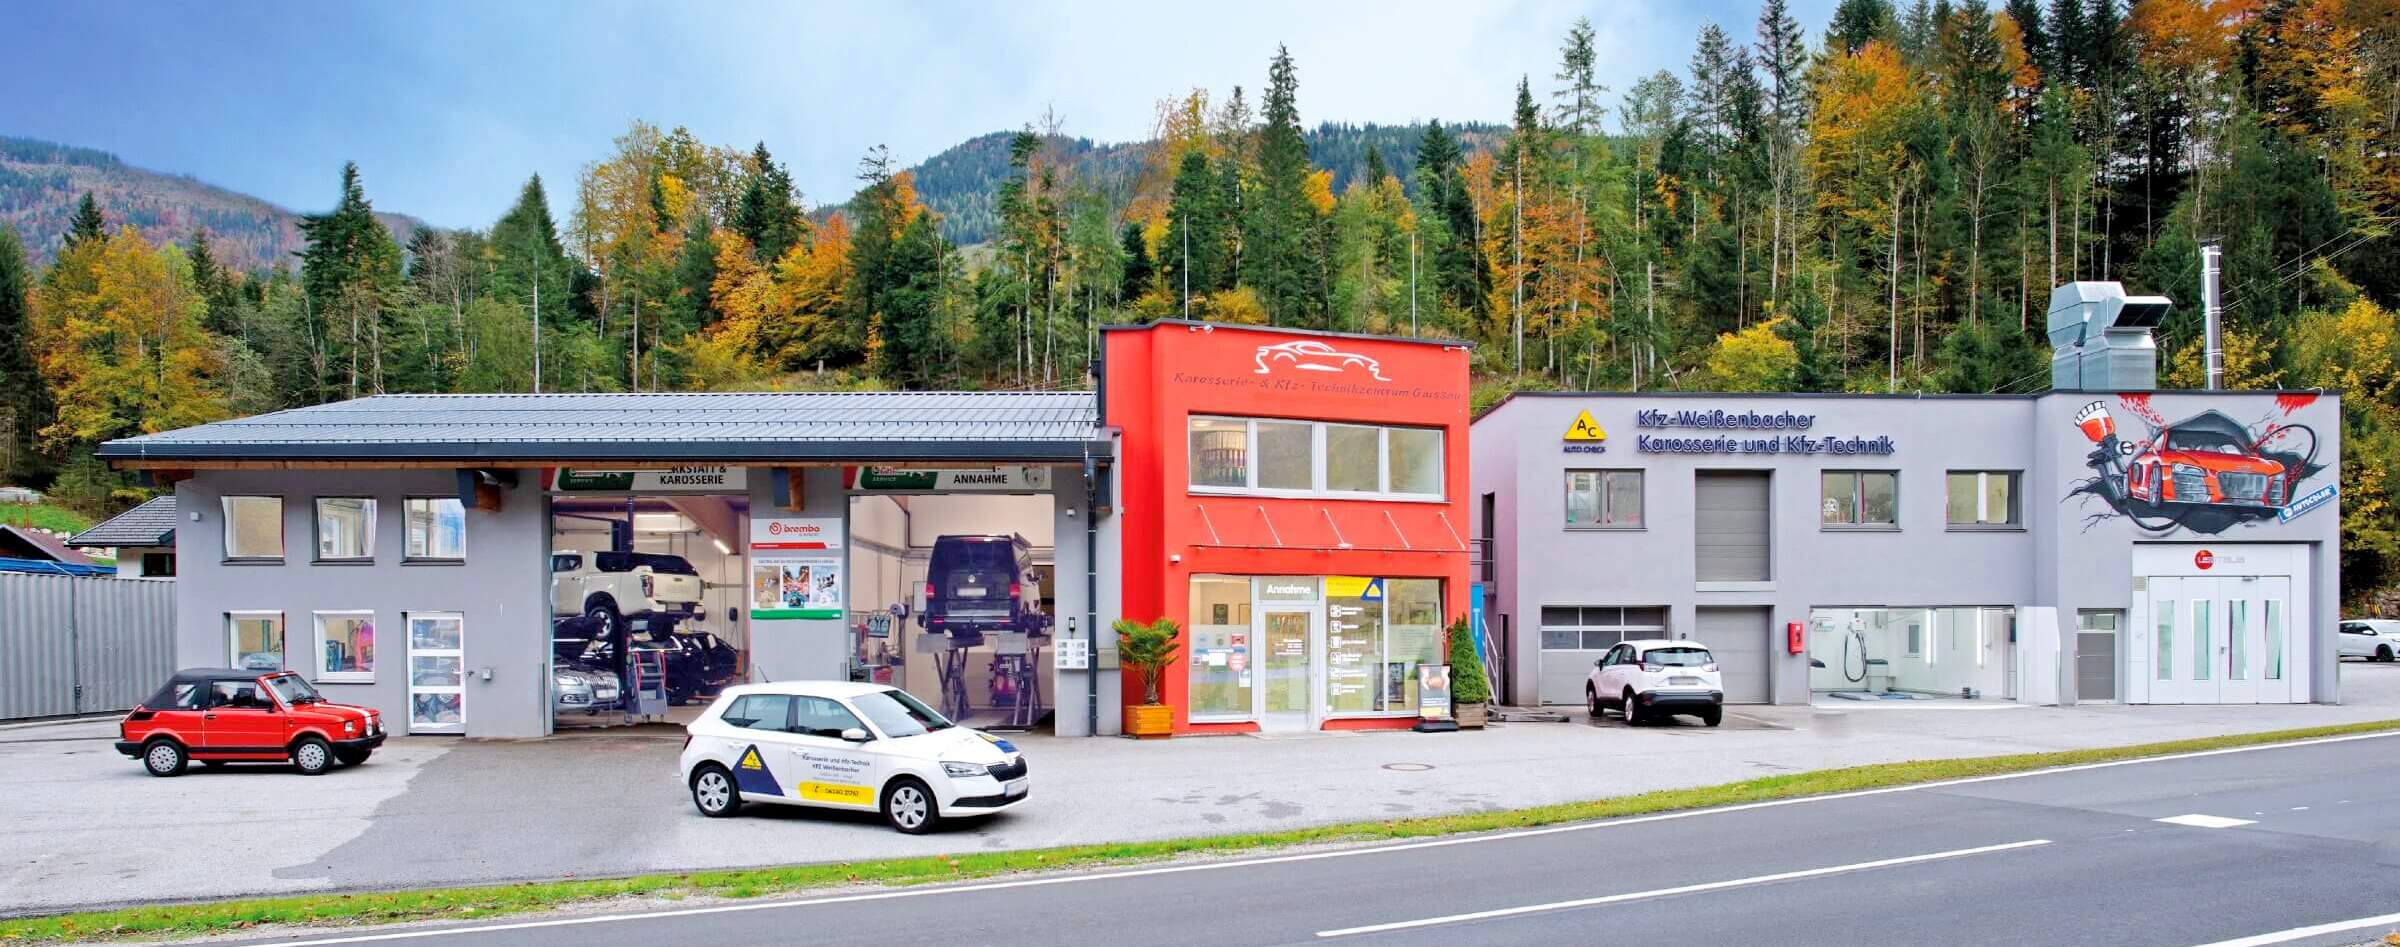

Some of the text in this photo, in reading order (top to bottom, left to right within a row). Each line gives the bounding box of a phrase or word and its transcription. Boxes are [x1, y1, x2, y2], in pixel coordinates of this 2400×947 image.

[1260, 379, 1270, 389] &
[1637, 409, 1816, 428] Kfz-Weißenbacher
[1637, 434, 1895, 454] Karosserie und Kfz-Technik
[660, 475, 724, 485] KAROSSERIE
[953, 474, 1008, 484] ANNAHME
[784, 524, 821, 532] brembo
[1266, 584, 1312, 594] Annahme
